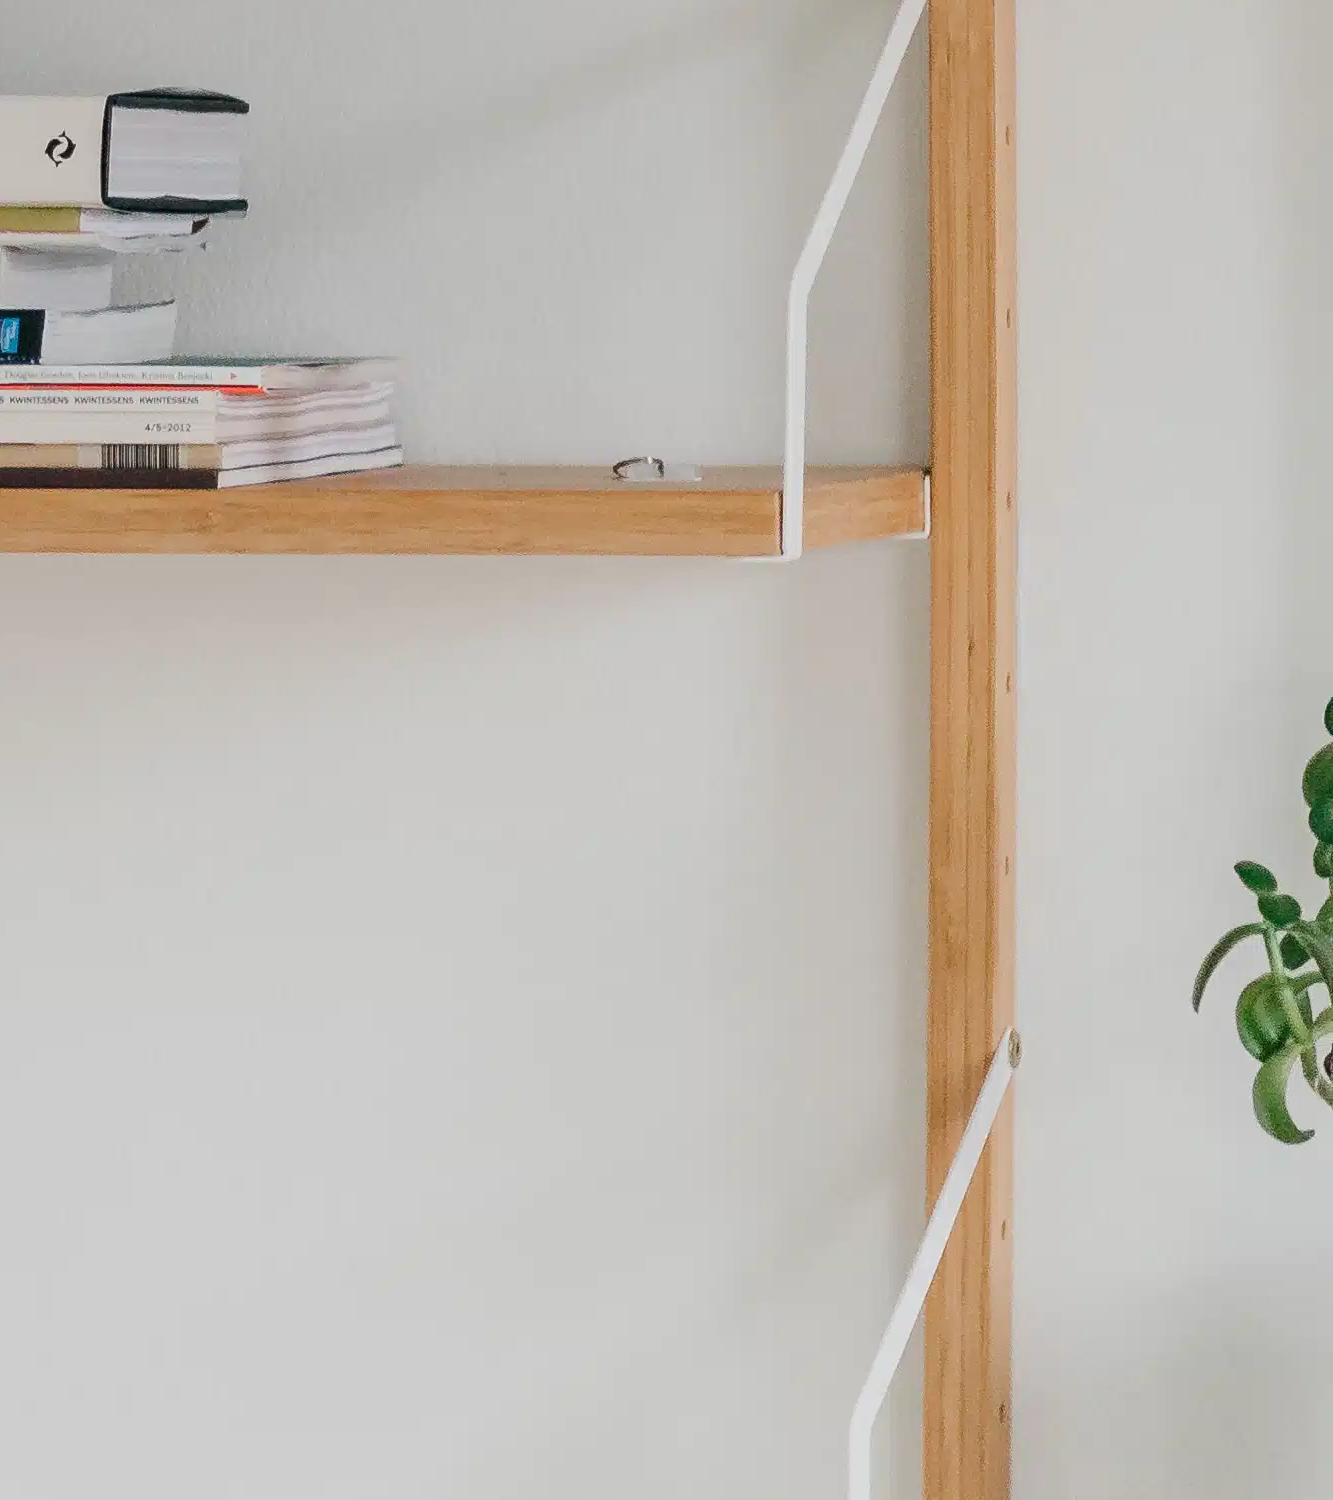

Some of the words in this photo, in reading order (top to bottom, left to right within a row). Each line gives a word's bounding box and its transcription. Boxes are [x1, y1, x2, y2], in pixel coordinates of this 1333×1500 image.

[9, 396, 69, 405] KWINTESSENS
[74, 396, 134, 405] KWINTESSENS
[139, 396, 199, 406] KWINTESSENS
